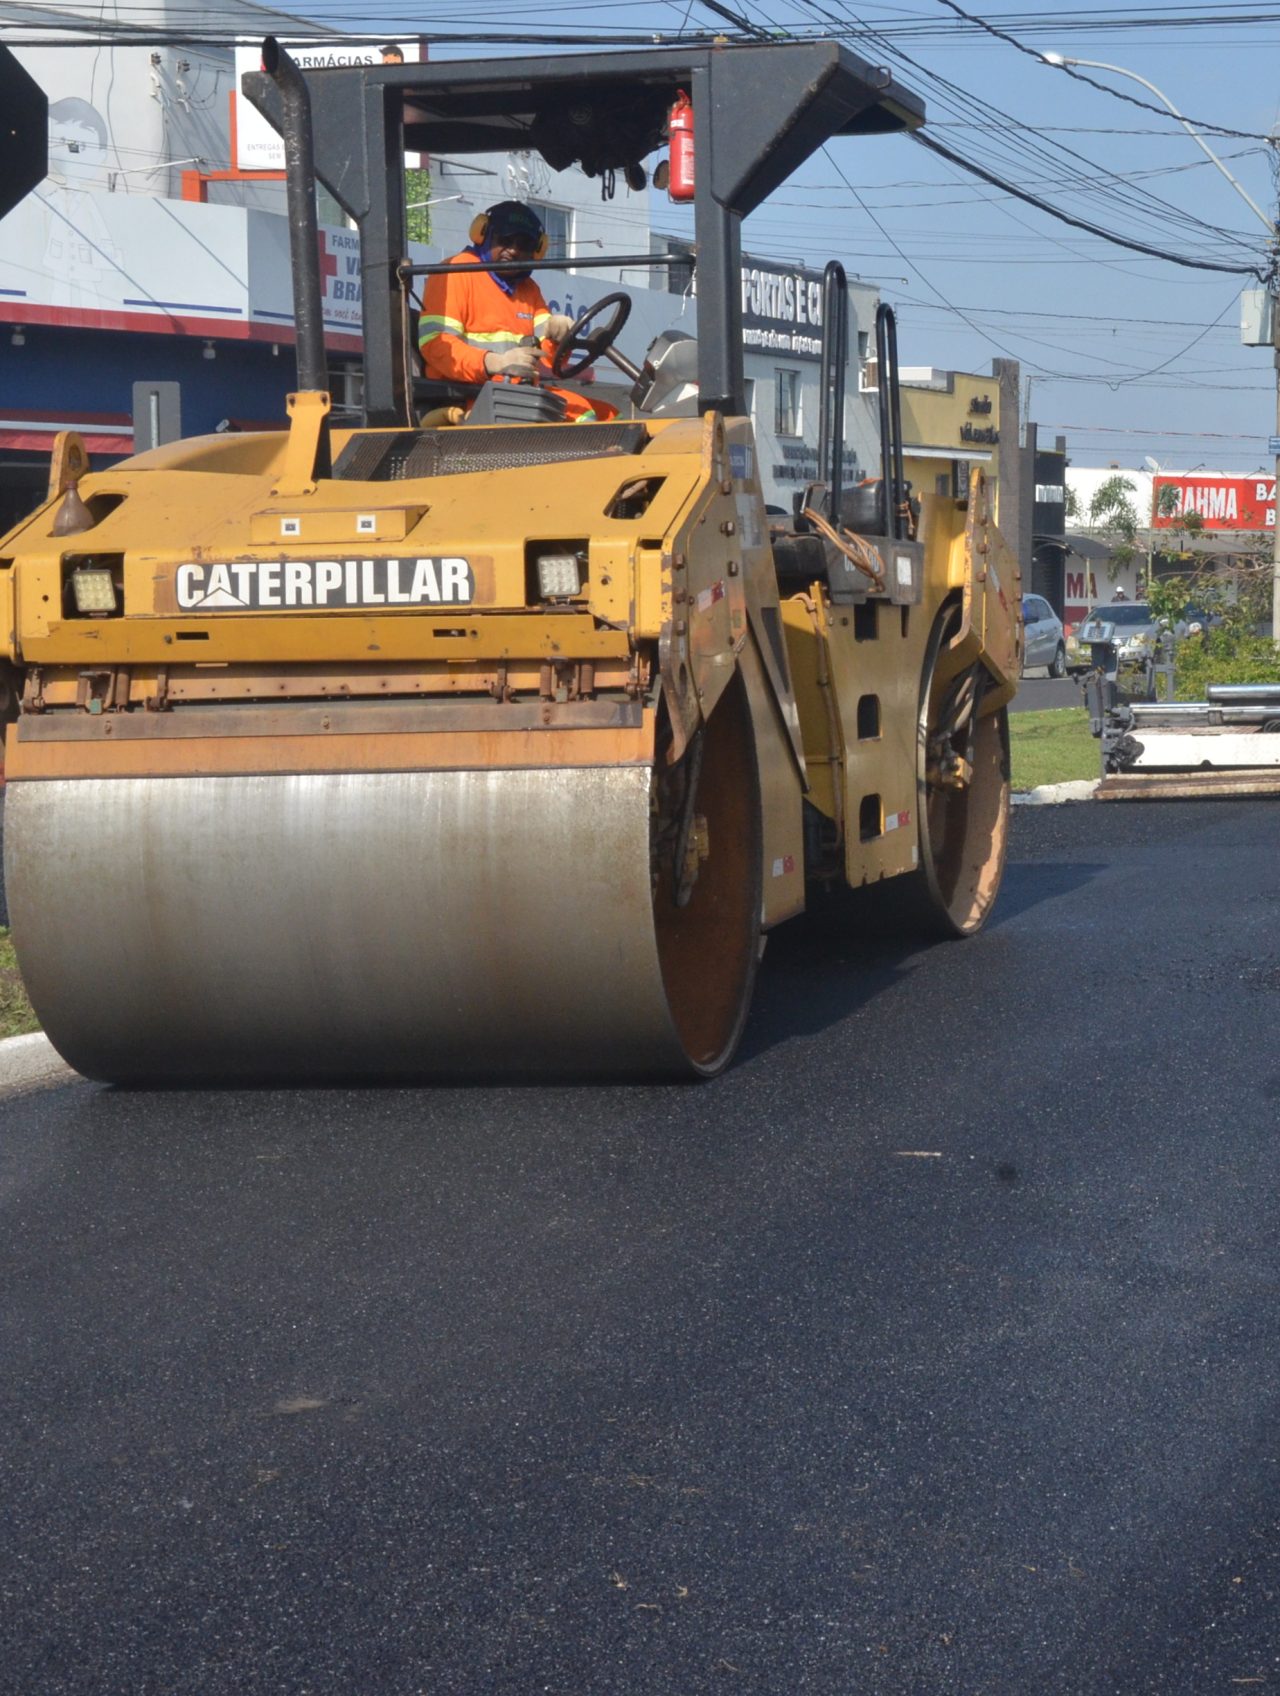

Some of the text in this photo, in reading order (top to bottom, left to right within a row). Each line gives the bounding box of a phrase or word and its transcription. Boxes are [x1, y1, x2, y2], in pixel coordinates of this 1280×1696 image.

[292, 54, 373, 68] ARMÁCIAS
[741, 267, 795, 322] PORTAS
[1158, 486, 1238, 519] RAHMA
[177, 558, 470, 607] CATERPILLAR
